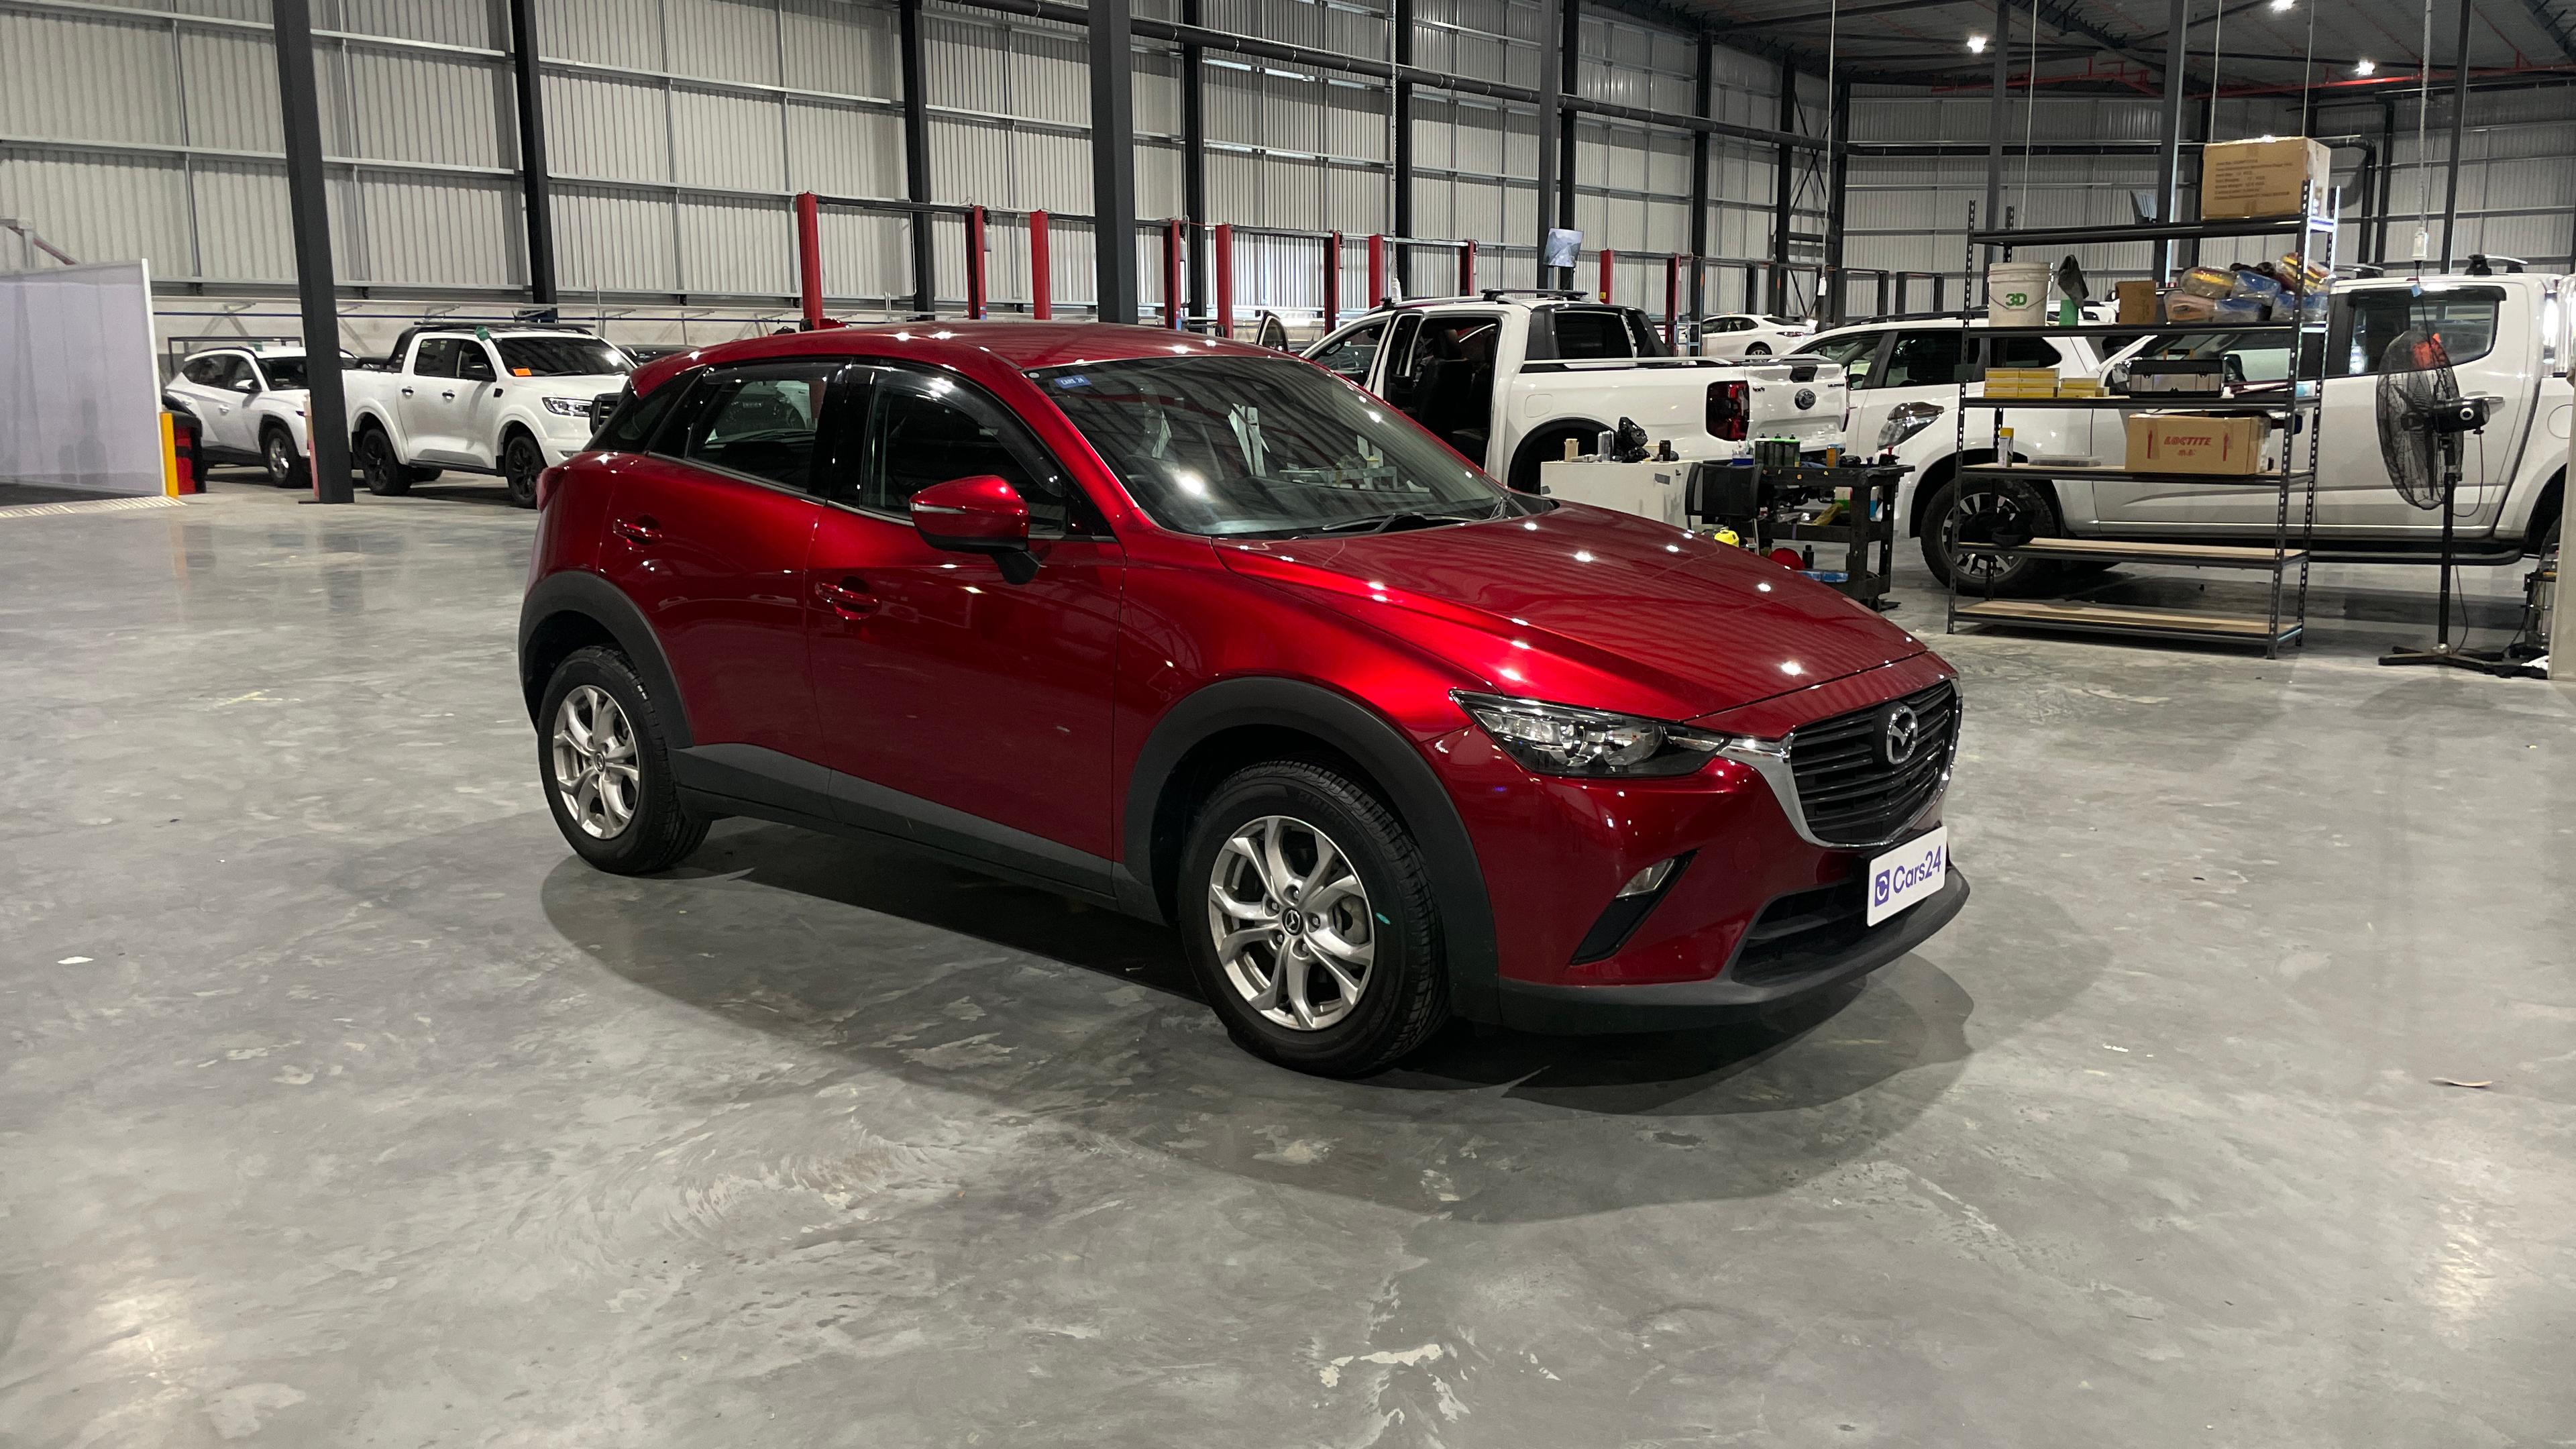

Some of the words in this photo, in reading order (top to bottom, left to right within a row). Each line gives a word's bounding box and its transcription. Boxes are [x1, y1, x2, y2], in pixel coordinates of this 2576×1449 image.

[2005, 292, 2027, 307] 3D
[2163, 436, 2212, 446] LOCTITE
[1893, 845, 1941, 894] Cars24
